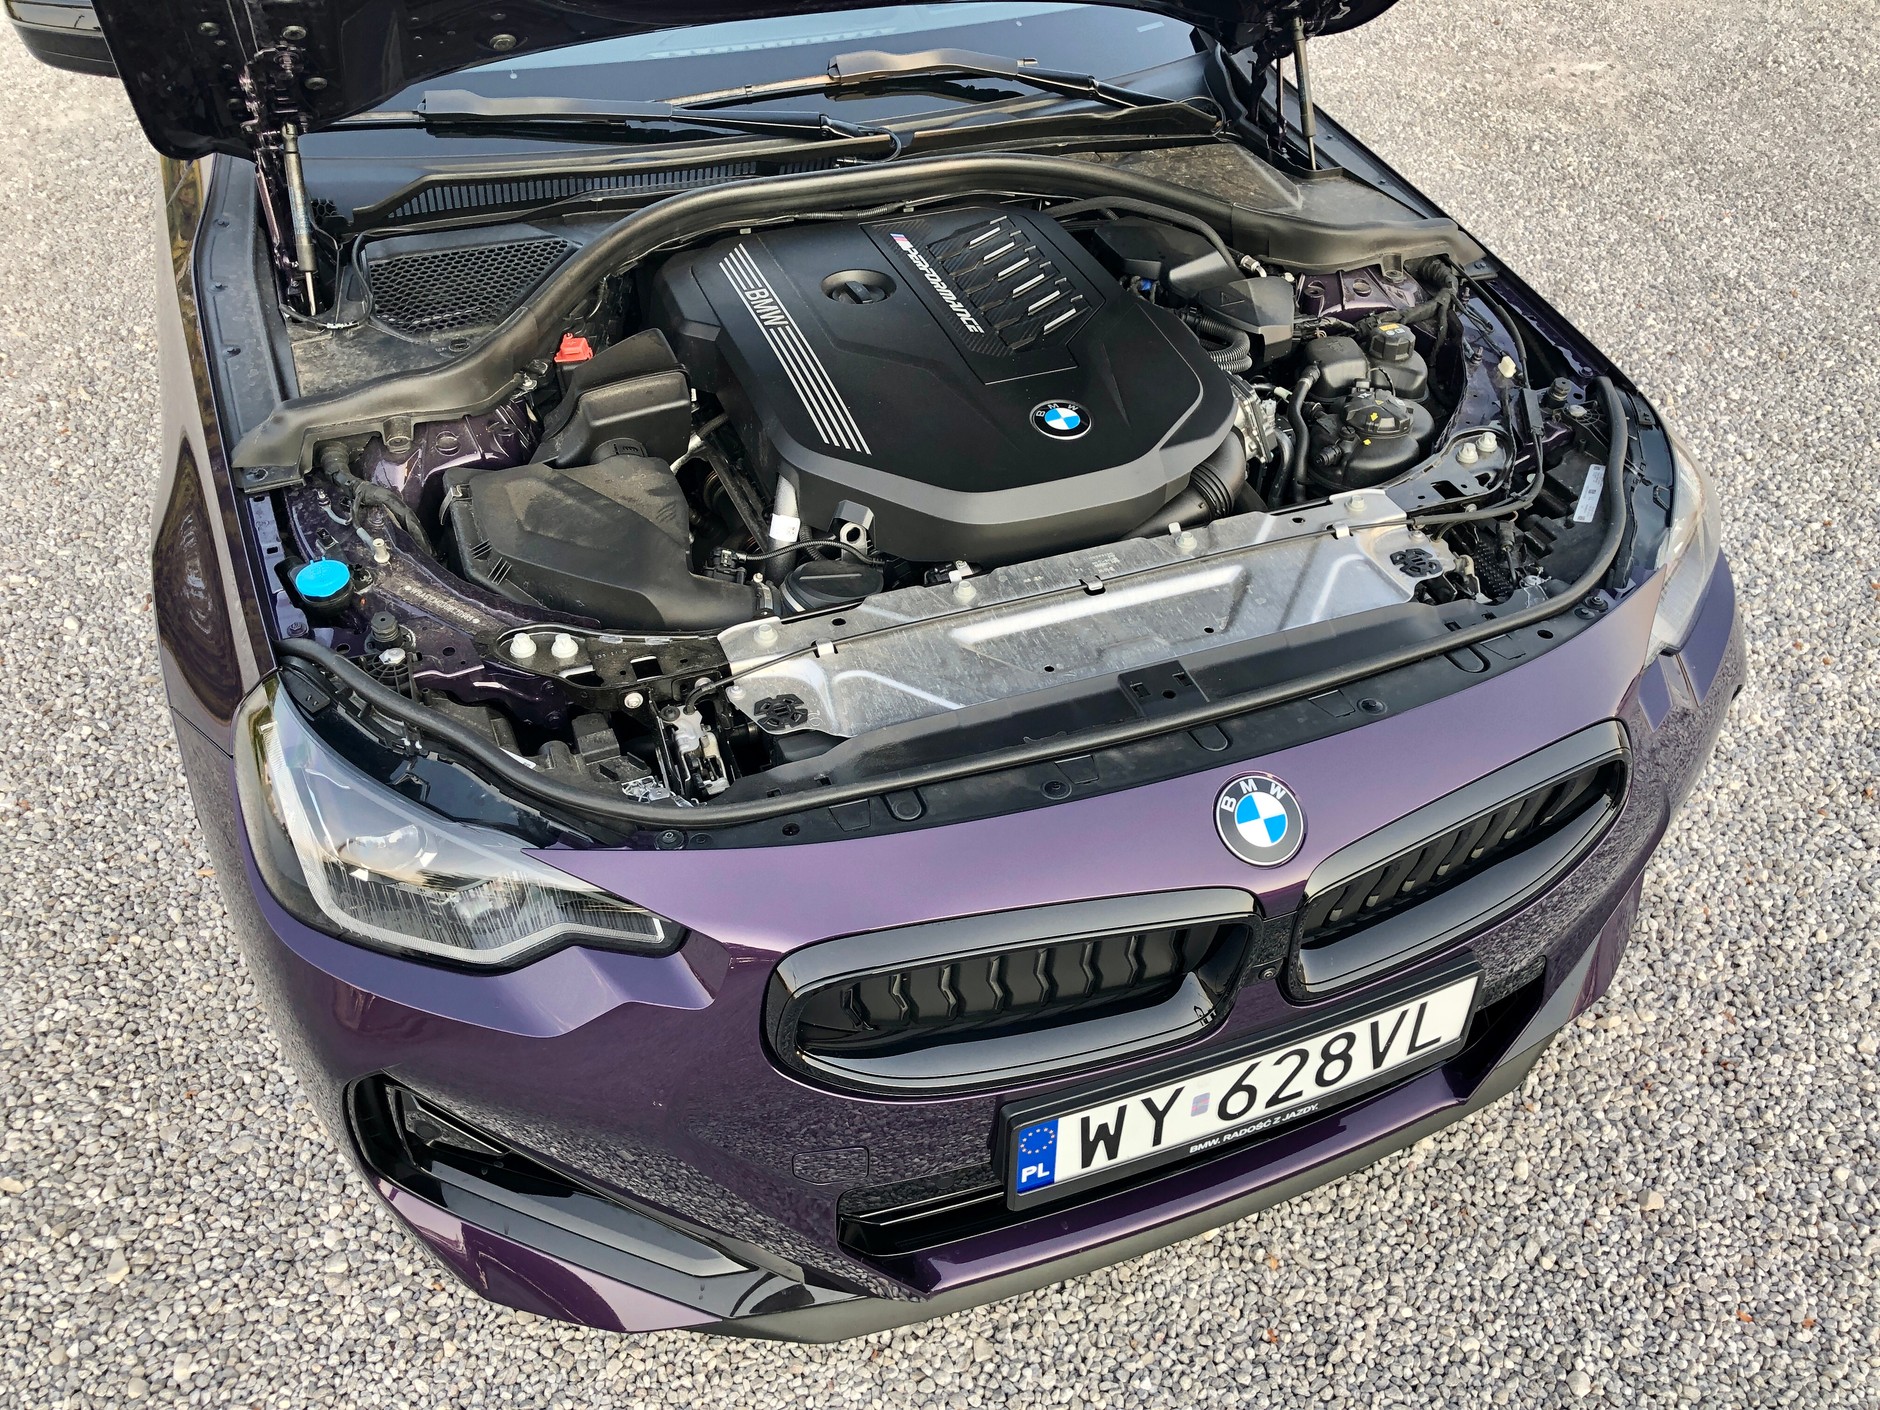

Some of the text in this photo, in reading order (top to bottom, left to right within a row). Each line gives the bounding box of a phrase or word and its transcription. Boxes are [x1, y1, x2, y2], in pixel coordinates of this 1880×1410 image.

[744, 288, 789, 326] BMW
[903, 247, 985, 334] PERFORMANCE
[1035, 403, 1079, 417] BMW
[1220, 778, 1287, 813] BMW
[1080, 1001, 1442, 1170] WY 628VL
[1189, 1103, 1318, 1154] BMW. RADOŚĆ Z JAZDY.
[1021, 1162, 1050, 1183] PL
